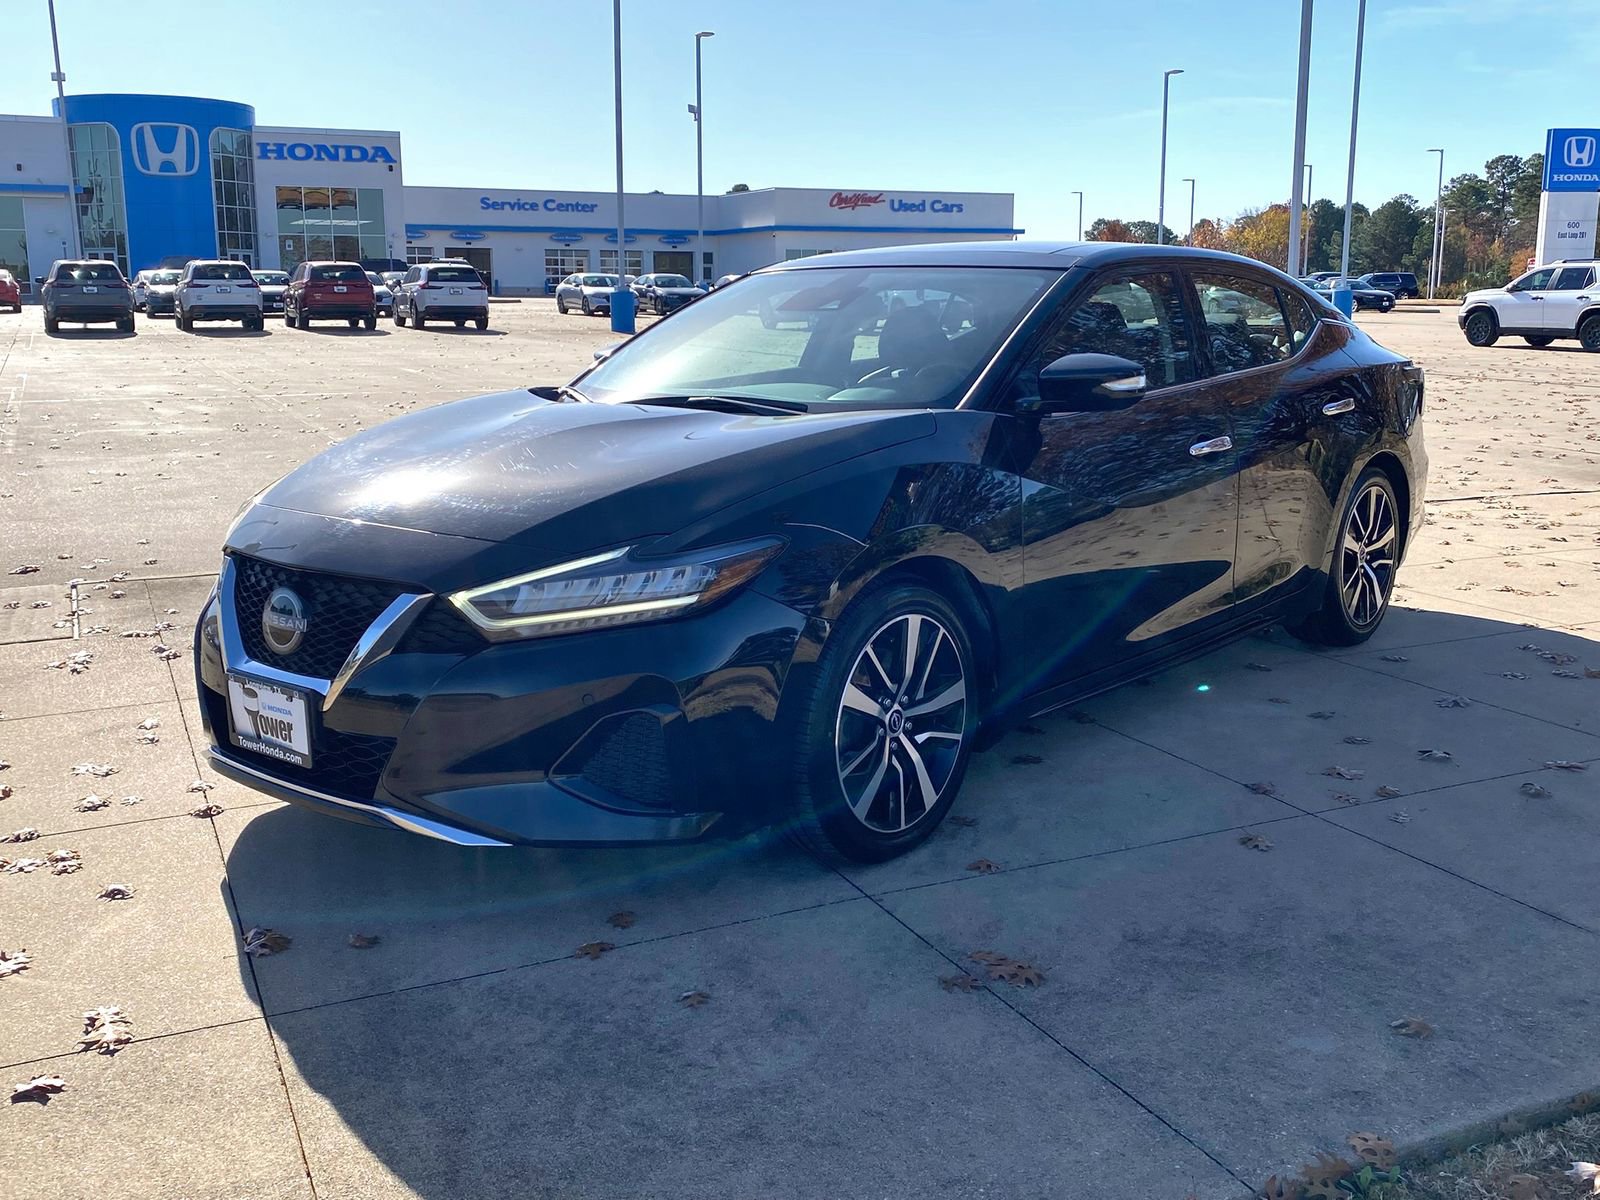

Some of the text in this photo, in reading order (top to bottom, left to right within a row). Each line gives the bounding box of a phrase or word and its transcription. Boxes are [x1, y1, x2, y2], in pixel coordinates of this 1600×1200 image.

[256, 142, 397, 164] HONDA
[1552, 174, 1600, 182] HONDA
[480, 196, 598, 213] Service Center
[889, 199, 926, 212] Used
[930, 199, 964, 213] Cars
[1567, 221, 1580, 229] 600
[267, 614, 304, 630] ISSAN
[267, 703, 293, 717] HONDA
[243, 701, 294, 744] Tower
[237, 735, 303, 765] TowerHonda.com
